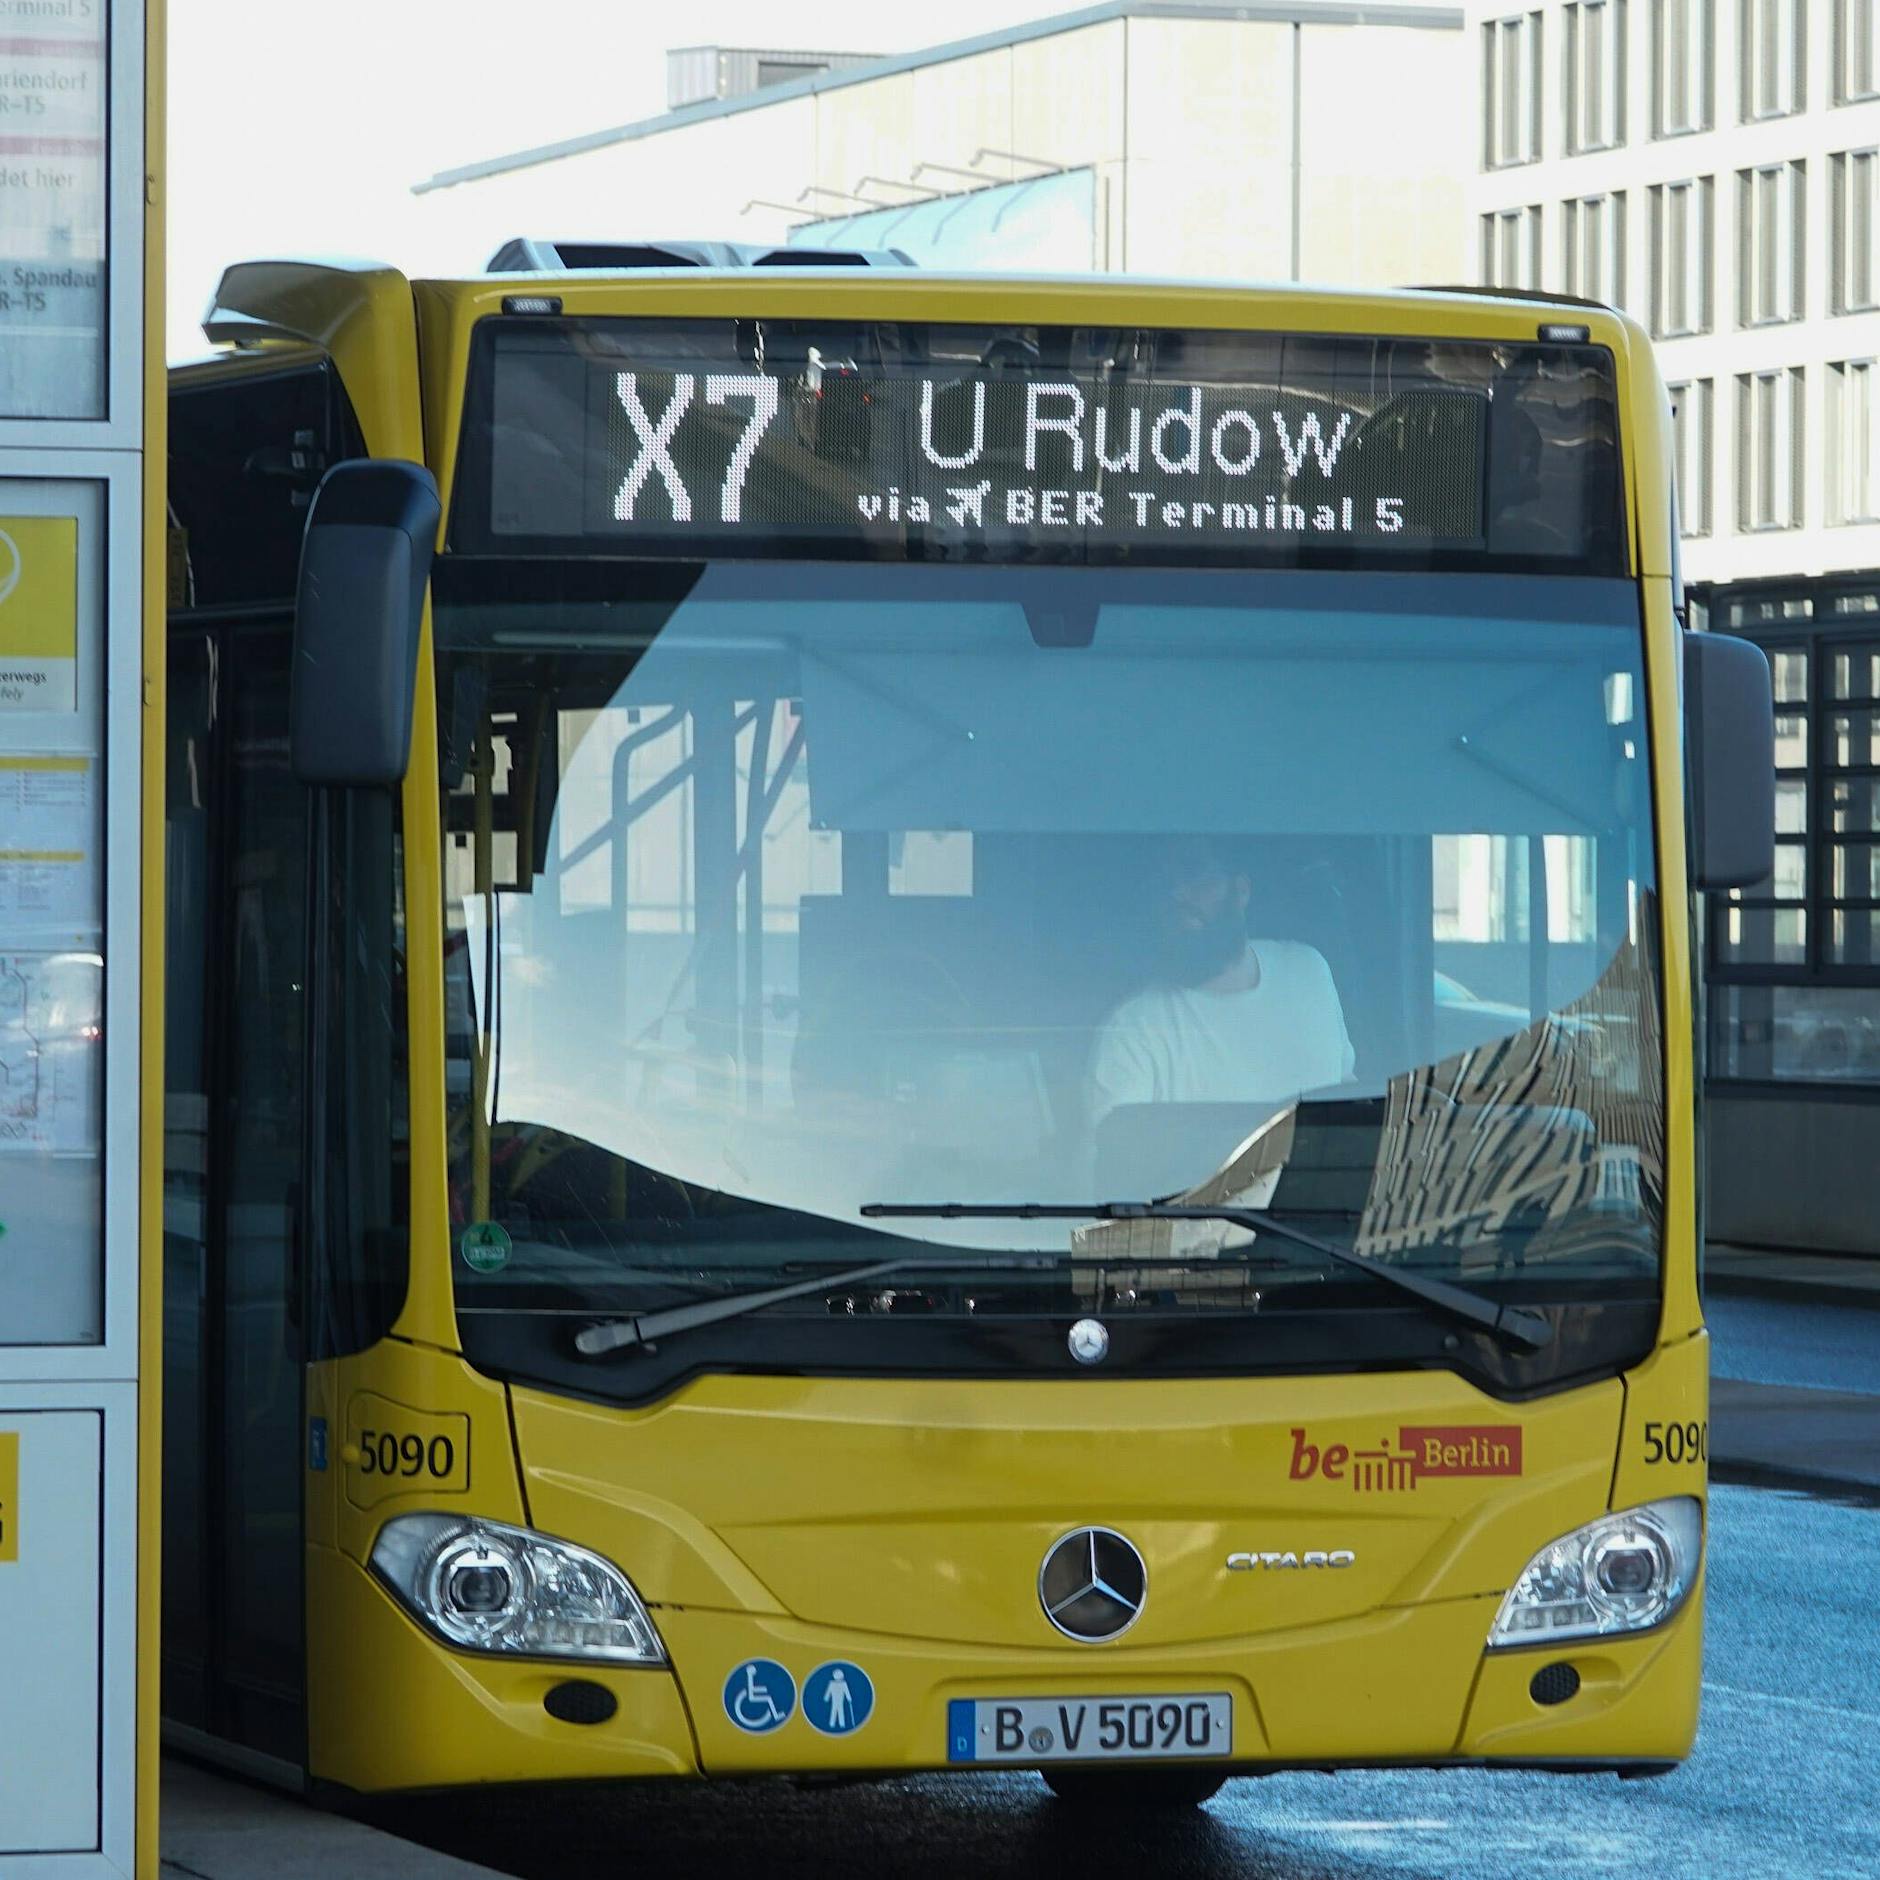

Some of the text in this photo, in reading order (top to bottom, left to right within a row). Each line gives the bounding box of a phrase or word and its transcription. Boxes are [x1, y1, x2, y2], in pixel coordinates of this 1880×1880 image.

[36, 166, 75, 187] hier
[14, 266, 97, 289] Spandau
[614, 372, 1351, 522] X7 U Rudow
[857, 488, 1404, 533] via BER Terminal 5
[361, 1429, 454, 1478] 5090
[1289, 1428, 1511, 1480] be Berlin
[1226, 1549, 1356, 1570] CITARO
[995, 1702, 1210, 1752] B V 5090
